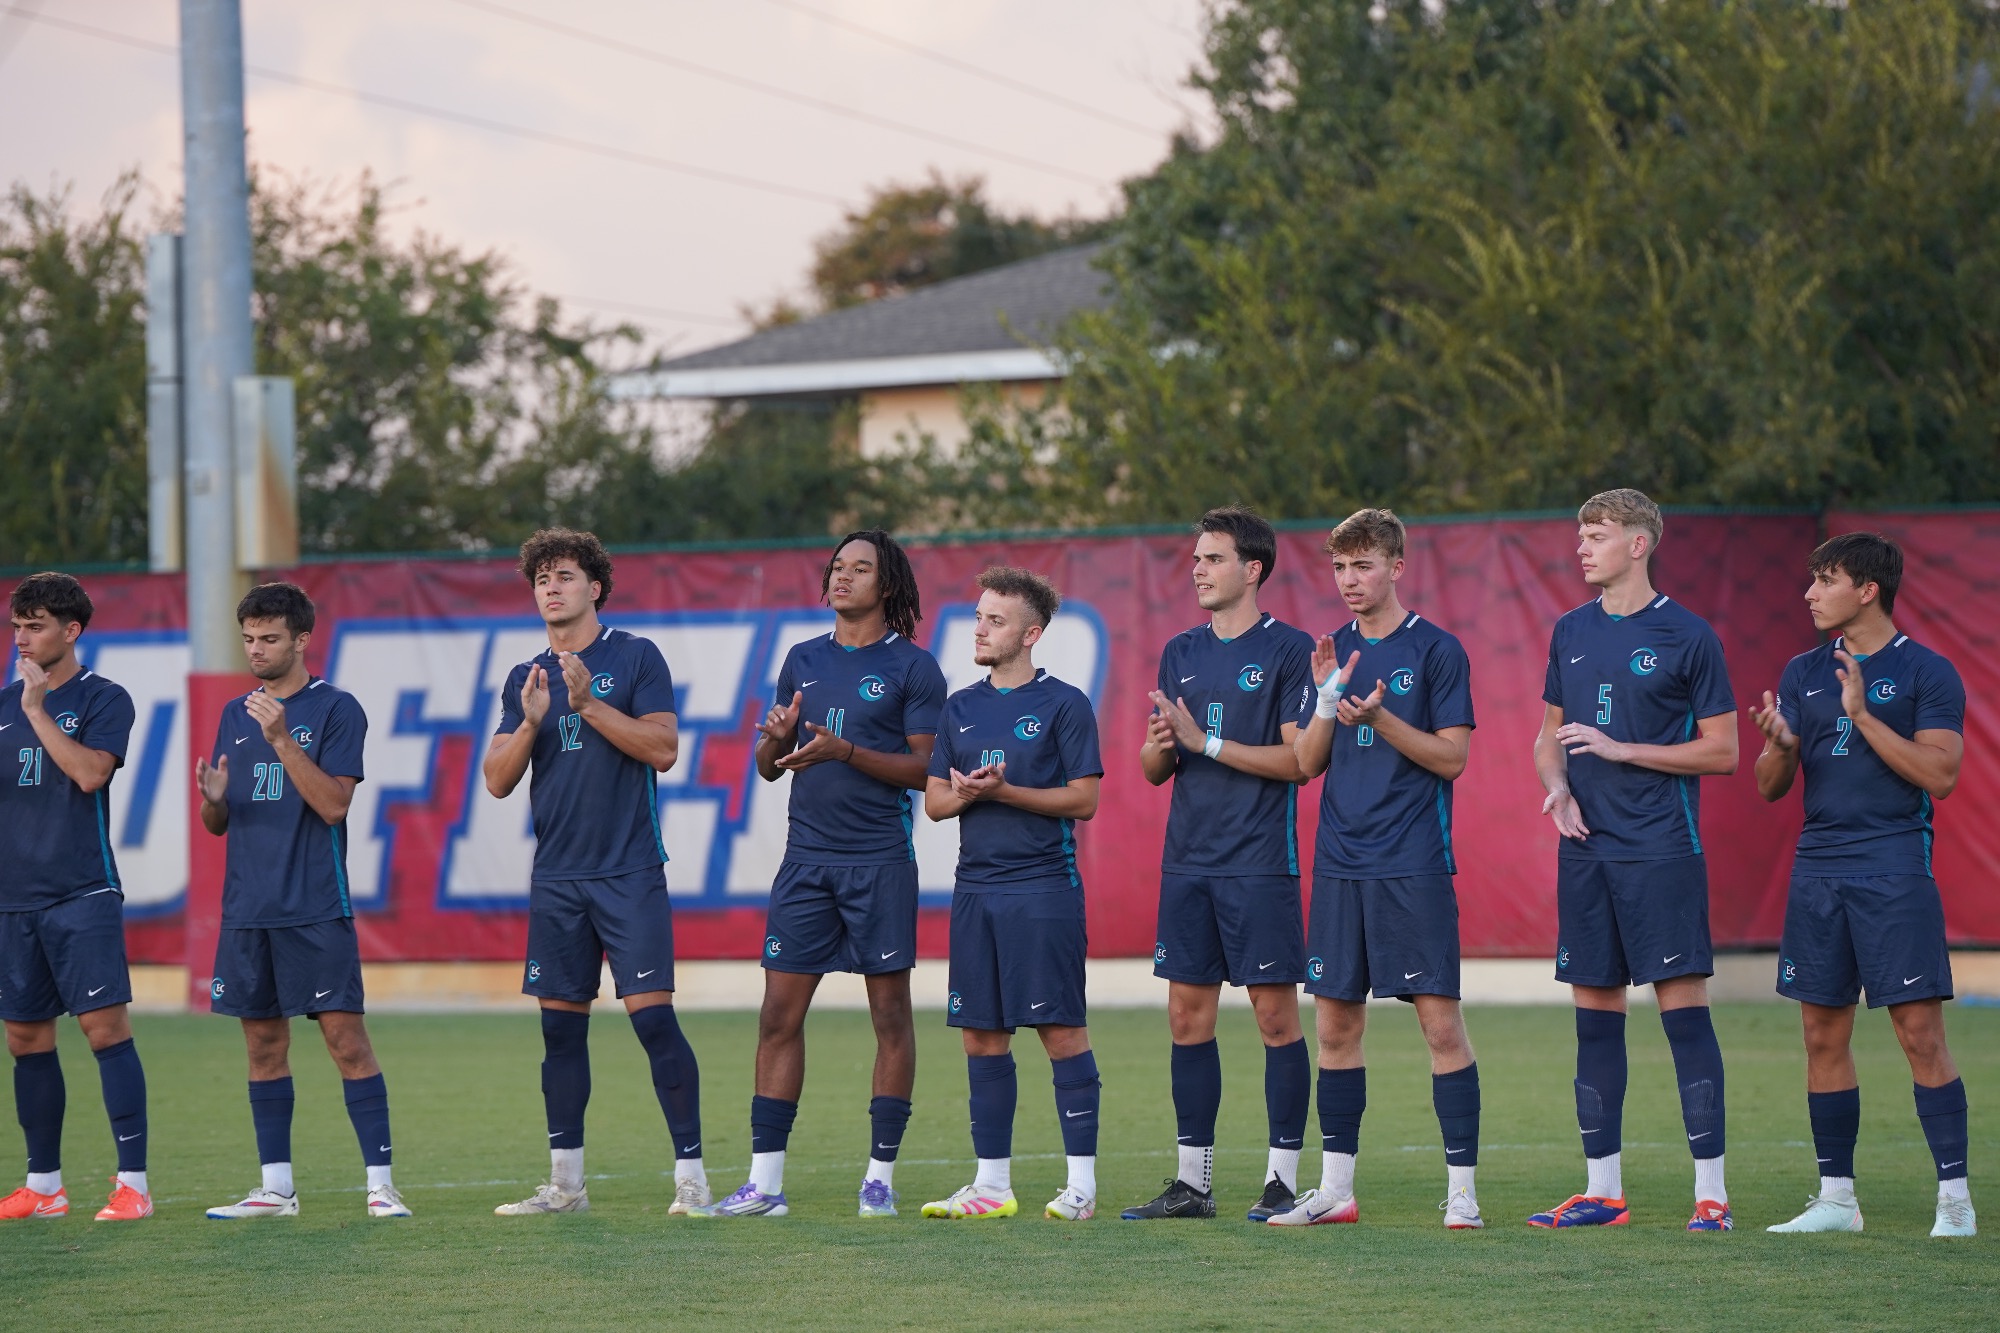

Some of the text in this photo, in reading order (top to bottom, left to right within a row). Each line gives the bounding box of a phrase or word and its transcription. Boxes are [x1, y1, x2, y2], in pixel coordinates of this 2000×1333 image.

[1643, 655, 1657, 667] EC
[601, 677, 614, 688] EC
[1250, 671, 1264, 682] EC
[1403, 674, 1414, 685] EC
[872, 682, 885, 694] EC
[1882, 684, 1896, 695] EC
[1596, 683, 1612, 725] 5
[66, 717, 79, 728] EC
[826, 708, 844, 738] 11
[1206, 702, 1223, 738] 9
[558, 713, 583, 752] 12
[1027, 722, 1041, 732] EC
[300, 732, 313, 742] EC
[1832, 717, 1852, 756] 2
[18, 747, 42, 786] 21
[252, 762, 284, 800] 20
